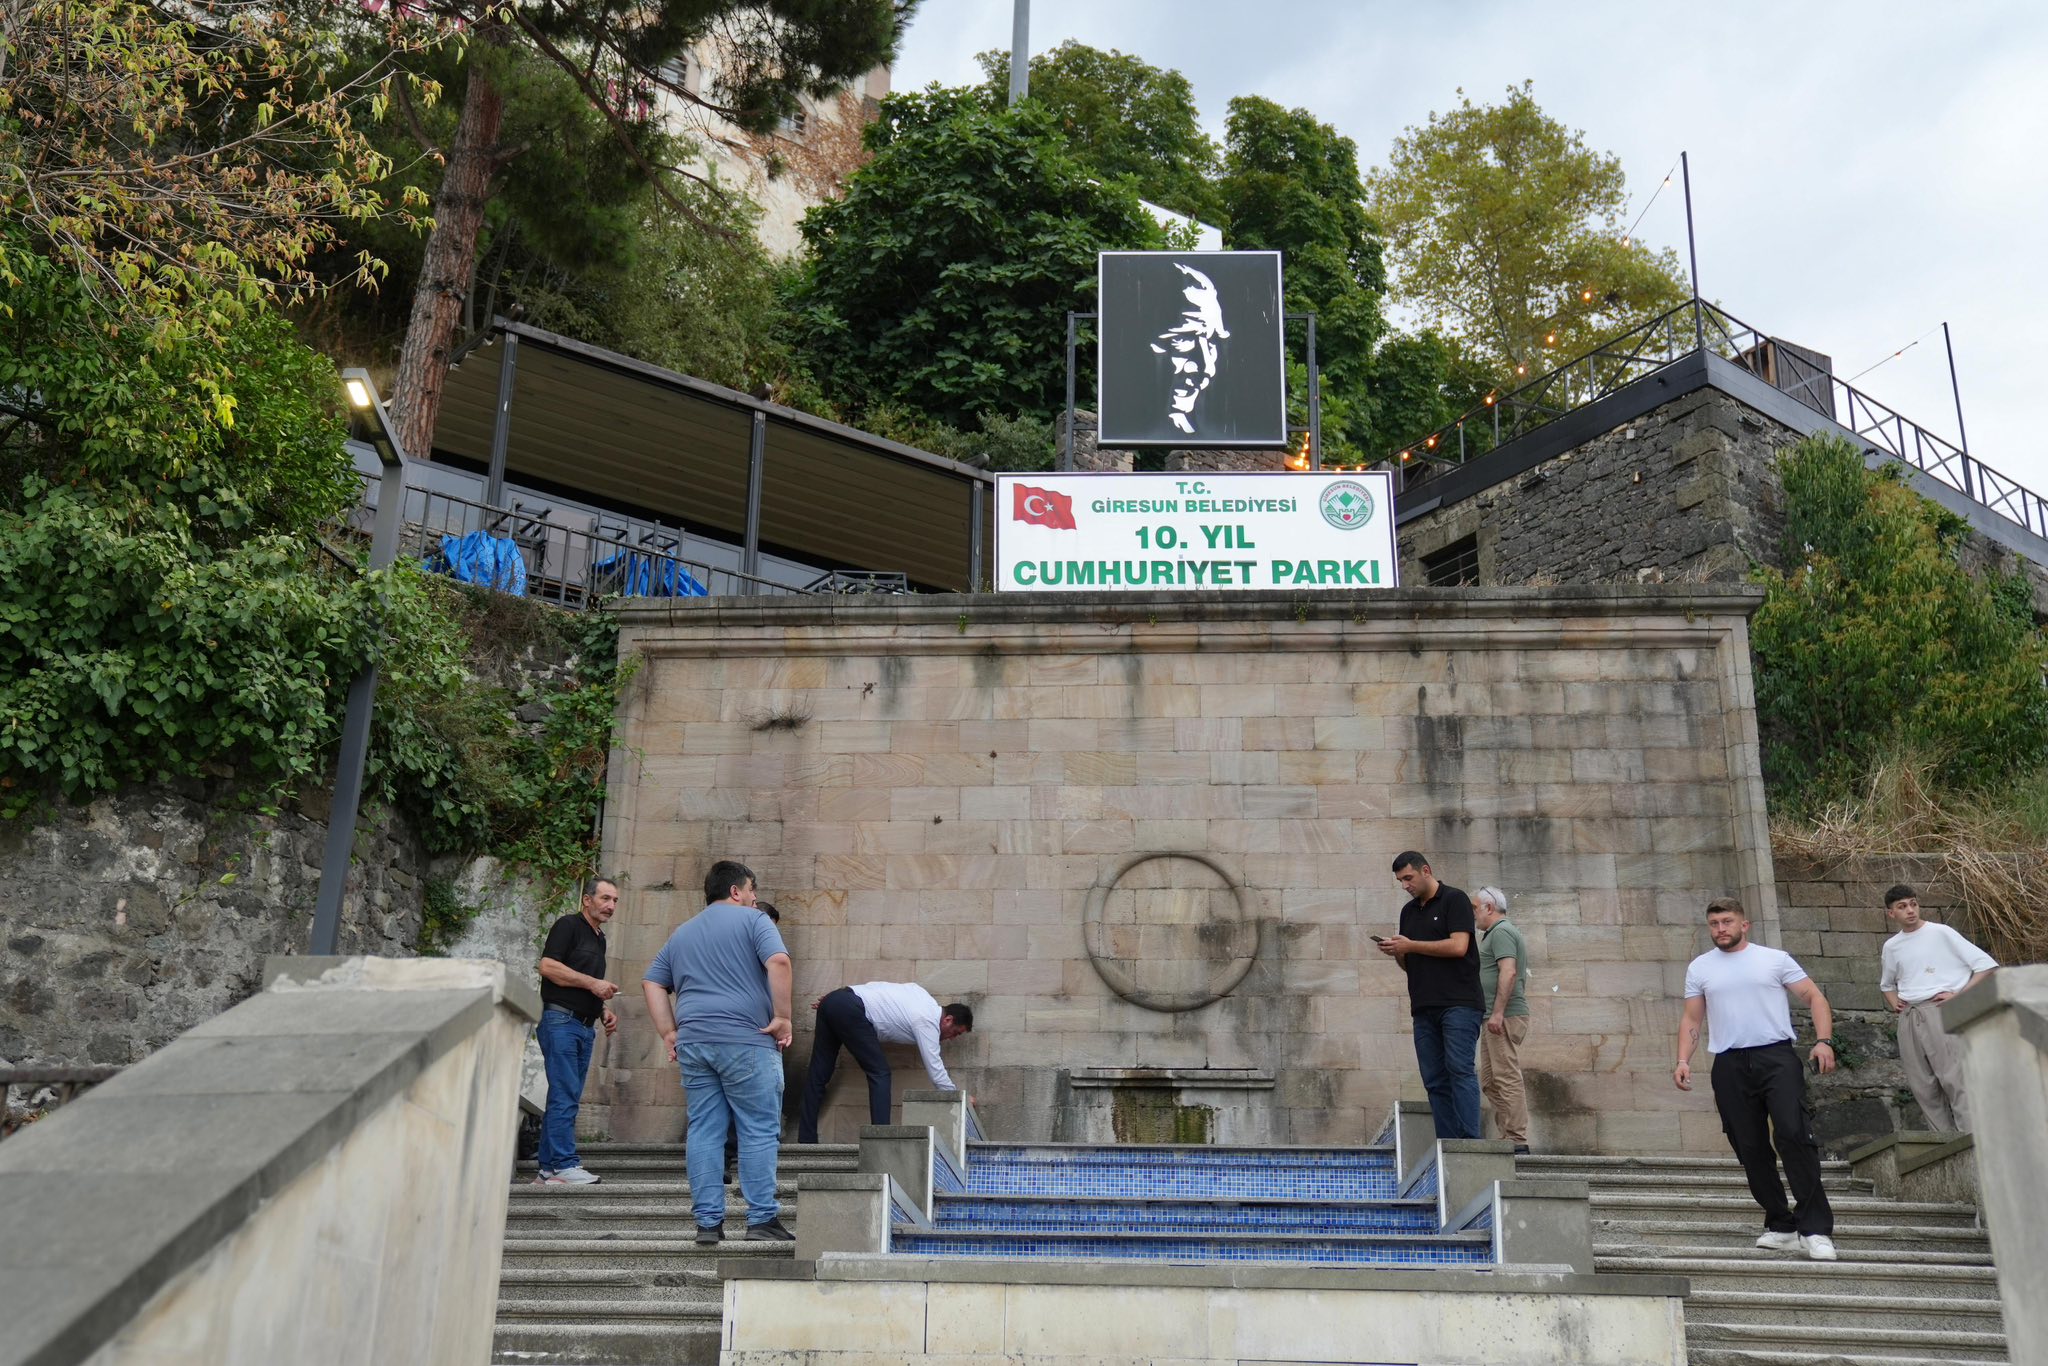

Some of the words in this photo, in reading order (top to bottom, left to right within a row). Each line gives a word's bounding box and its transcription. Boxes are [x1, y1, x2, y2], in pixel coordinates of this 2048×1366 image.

[1176, 481, 1212, 495] T.C.
[1091, 497, 1178, 513] GİRESUN
[1184, 496, 1297, 513] BELEDİYESİ
[1135, 525, 1188, 550] 10.
[1199, 525, 1256, 549] YIL
[1013, 554, 1257, 585] CUMHURİYET
[1271, 560, 1381, 584] PARKI
